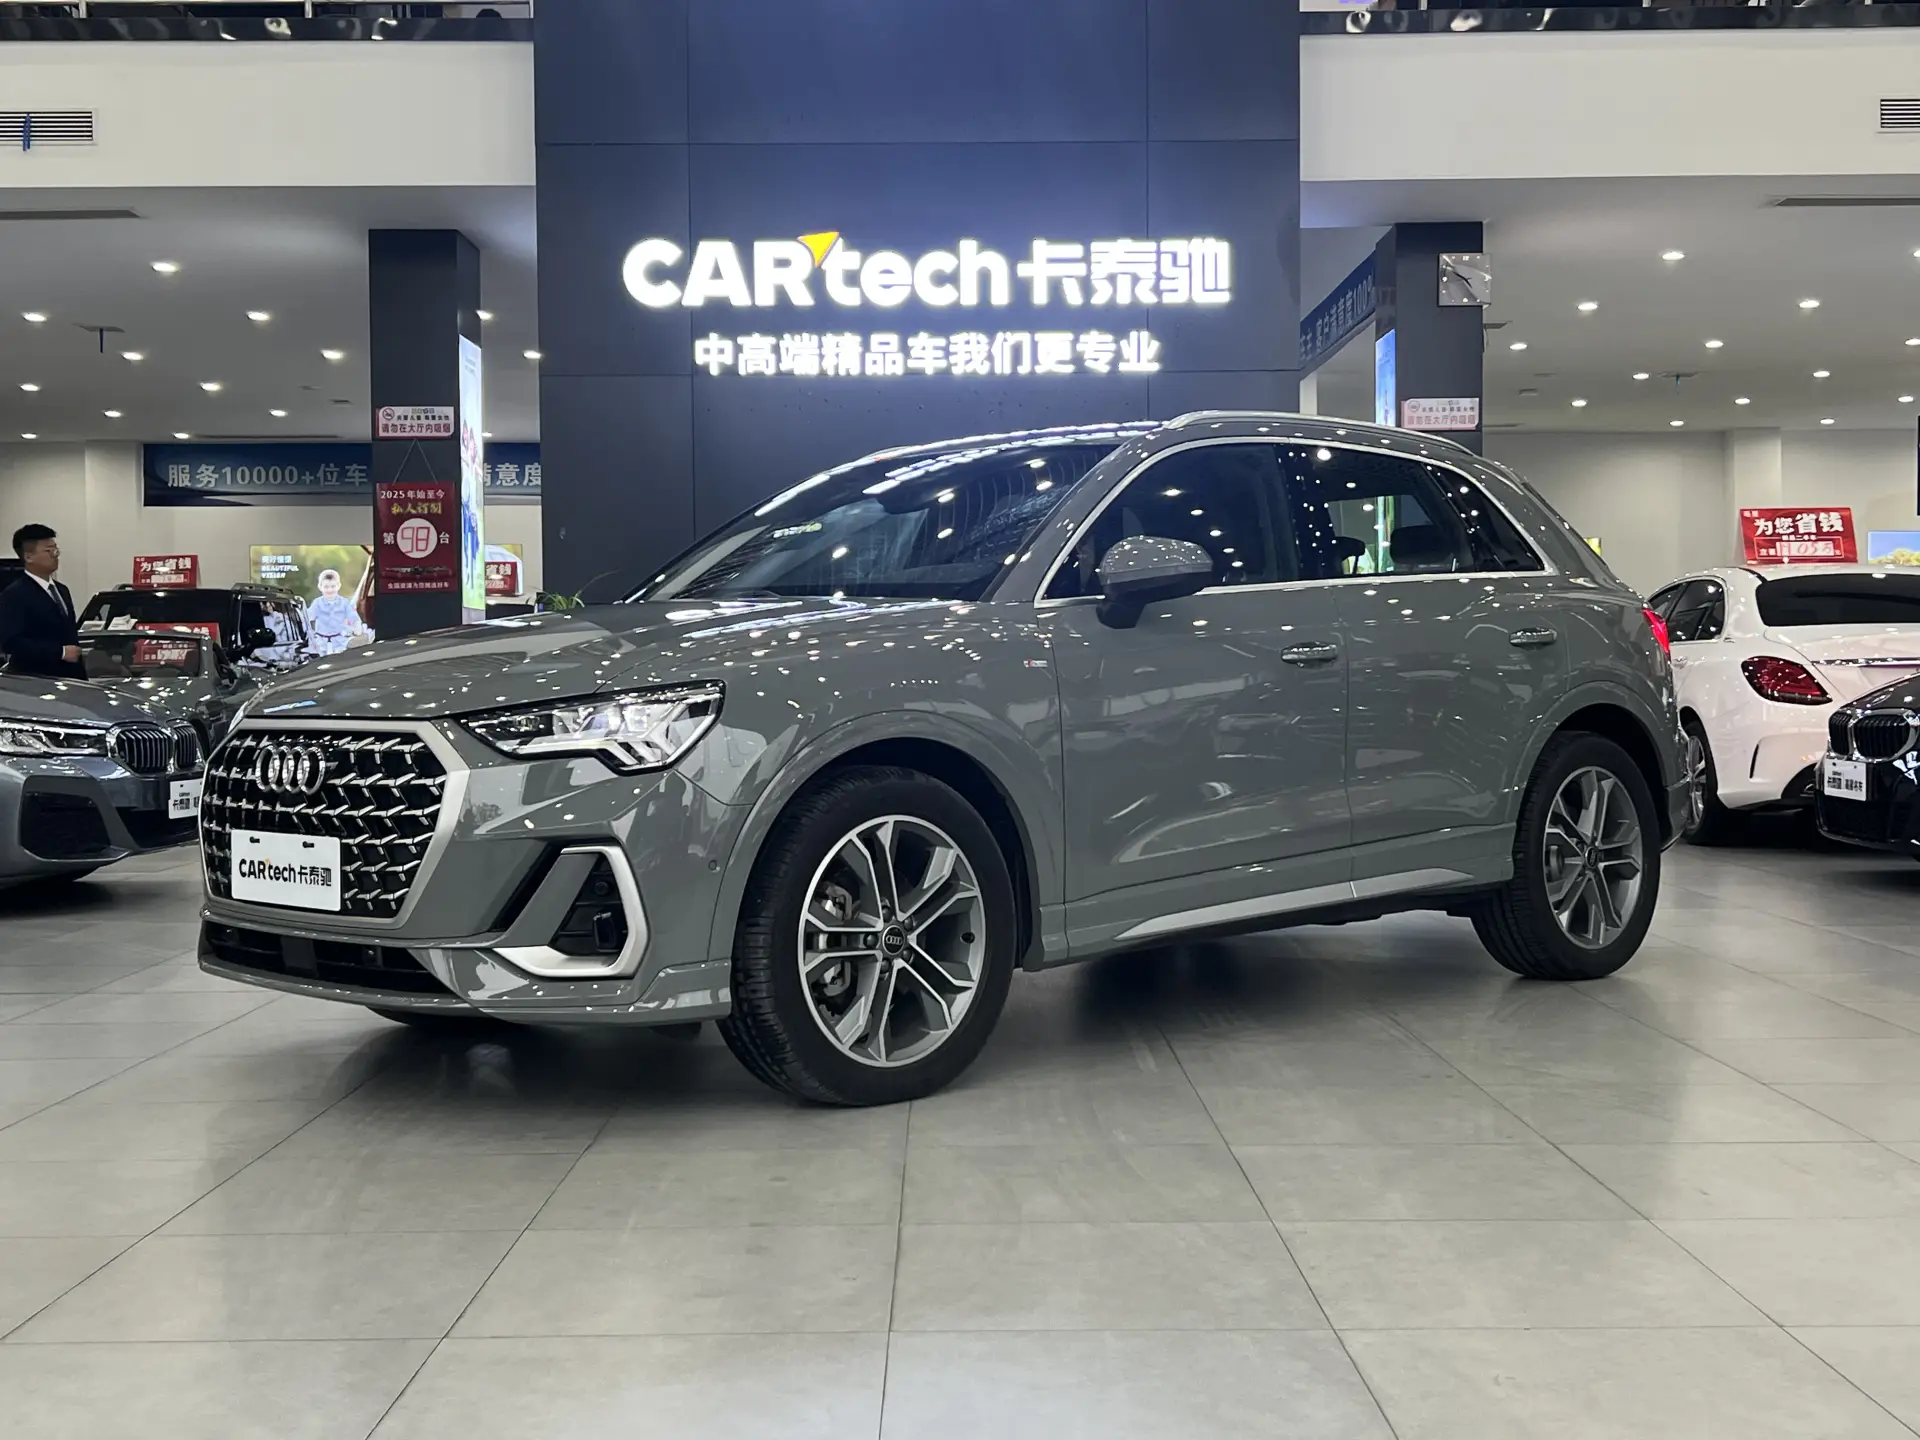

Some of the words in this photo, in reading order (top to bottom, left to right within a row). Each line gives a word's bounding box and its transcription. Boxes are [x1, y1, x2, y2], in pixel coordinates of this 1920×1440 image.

[622, 235, 1009, 308] CARtech
[1017, 236, 1232, 306] 卡泰驰
[694, 331, 1162, 376] 中高端精品车我们更专业
[167, 463, 368, 488] 服务10000+位车
[1753, 511, 1845, 536] 为您省钱
[238, 858, 297, 883] CARtech
[297, 864, 332, 887] 卡泰驰
